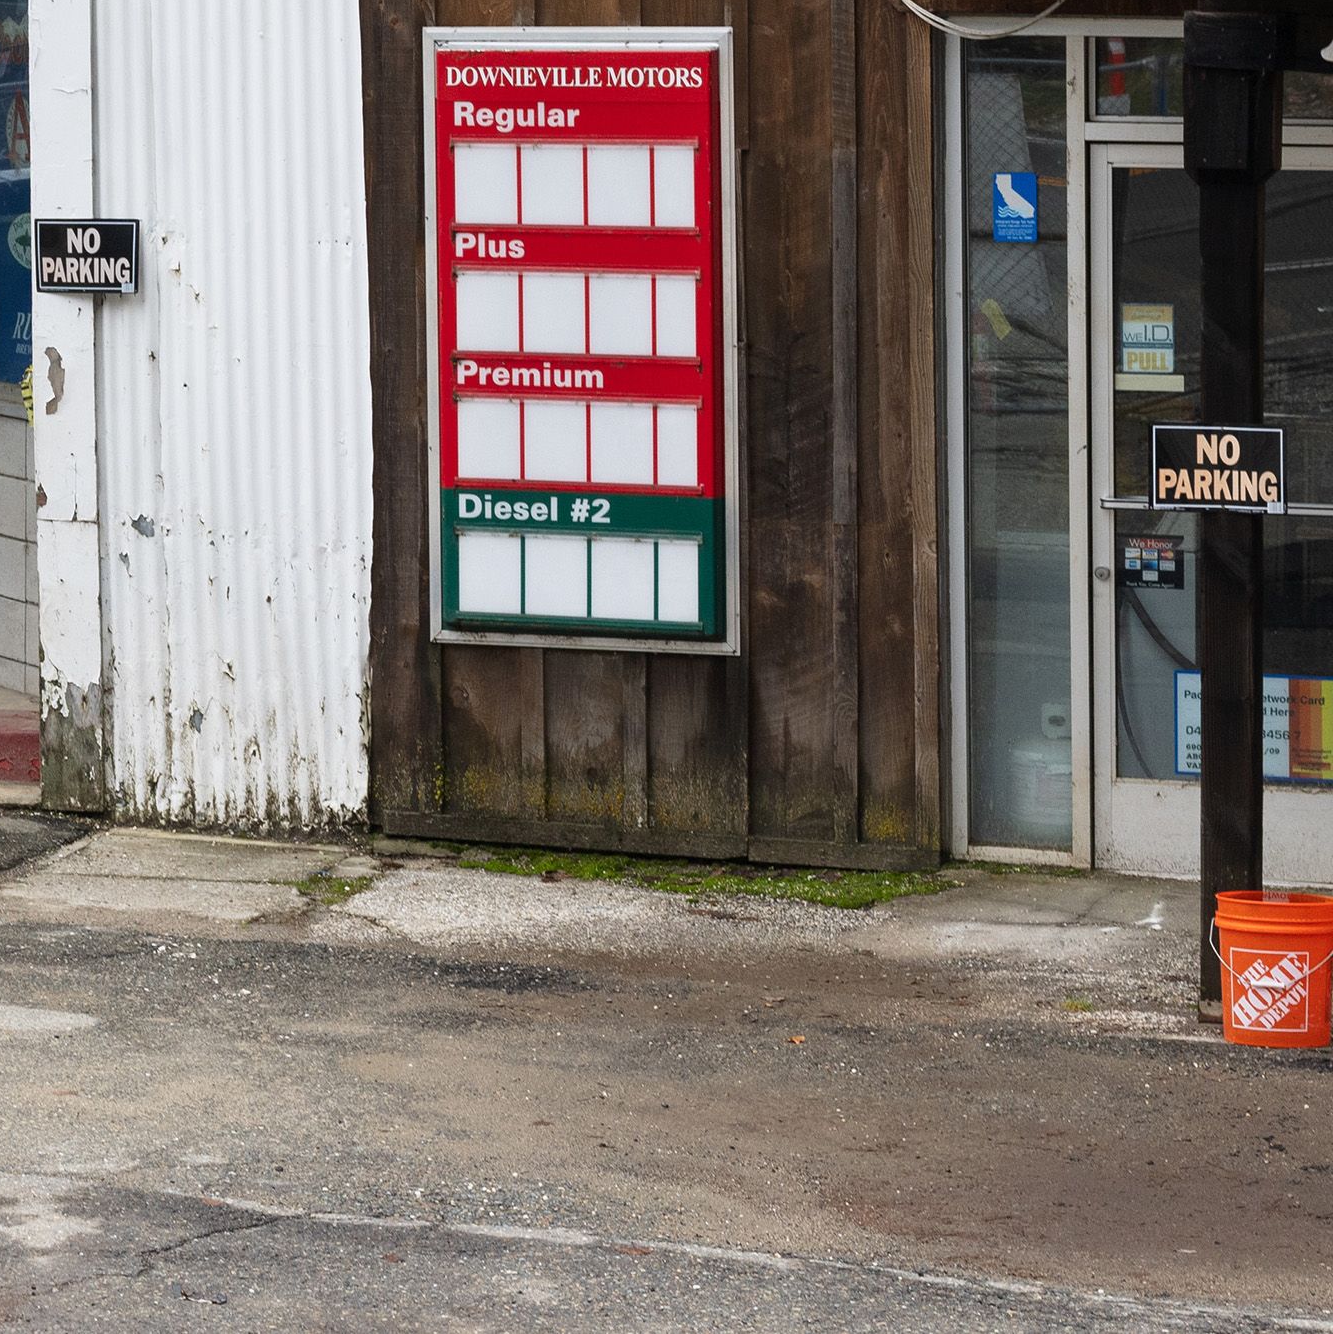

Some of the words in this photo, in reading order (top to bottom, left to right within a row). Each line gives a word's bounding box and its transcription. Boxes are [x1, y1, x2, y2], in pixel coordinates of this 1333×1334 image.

[445, 66, 603, 87] DOWNIEVILLE
[606, 66, 703, 88] MOTORS
[453, 101, 580, 133] Regular
[66, 227, 101, 254] NO
[455, 233, 526, 258] Plus
[41, 257, 131, 284] PARKING
[1124, 332, 1143, 342] WE
[1144, 324, 1172, 342] I.D.
[456, 360, 604, 389] Premium
[1127, 351, 1169, 371] PULL
[1196, 433, 1241, 466] NO
[1158, 468, 1278, 503] PARKING
[458, 493, 558, 521] Diesel
[570, 498, 611, 524] #2
[1128, 538, 1145, 548] We
[1147, 539, 1173, 549] Honor
[1270, 707, 1296, 716] Here
[1300, 695, 1325, 705] Card
[1237, 959, 1269, 989] THE
[1233, 953, 1308, 1027] HOME
[1260, 982, 1308, 1029] DEPOT
